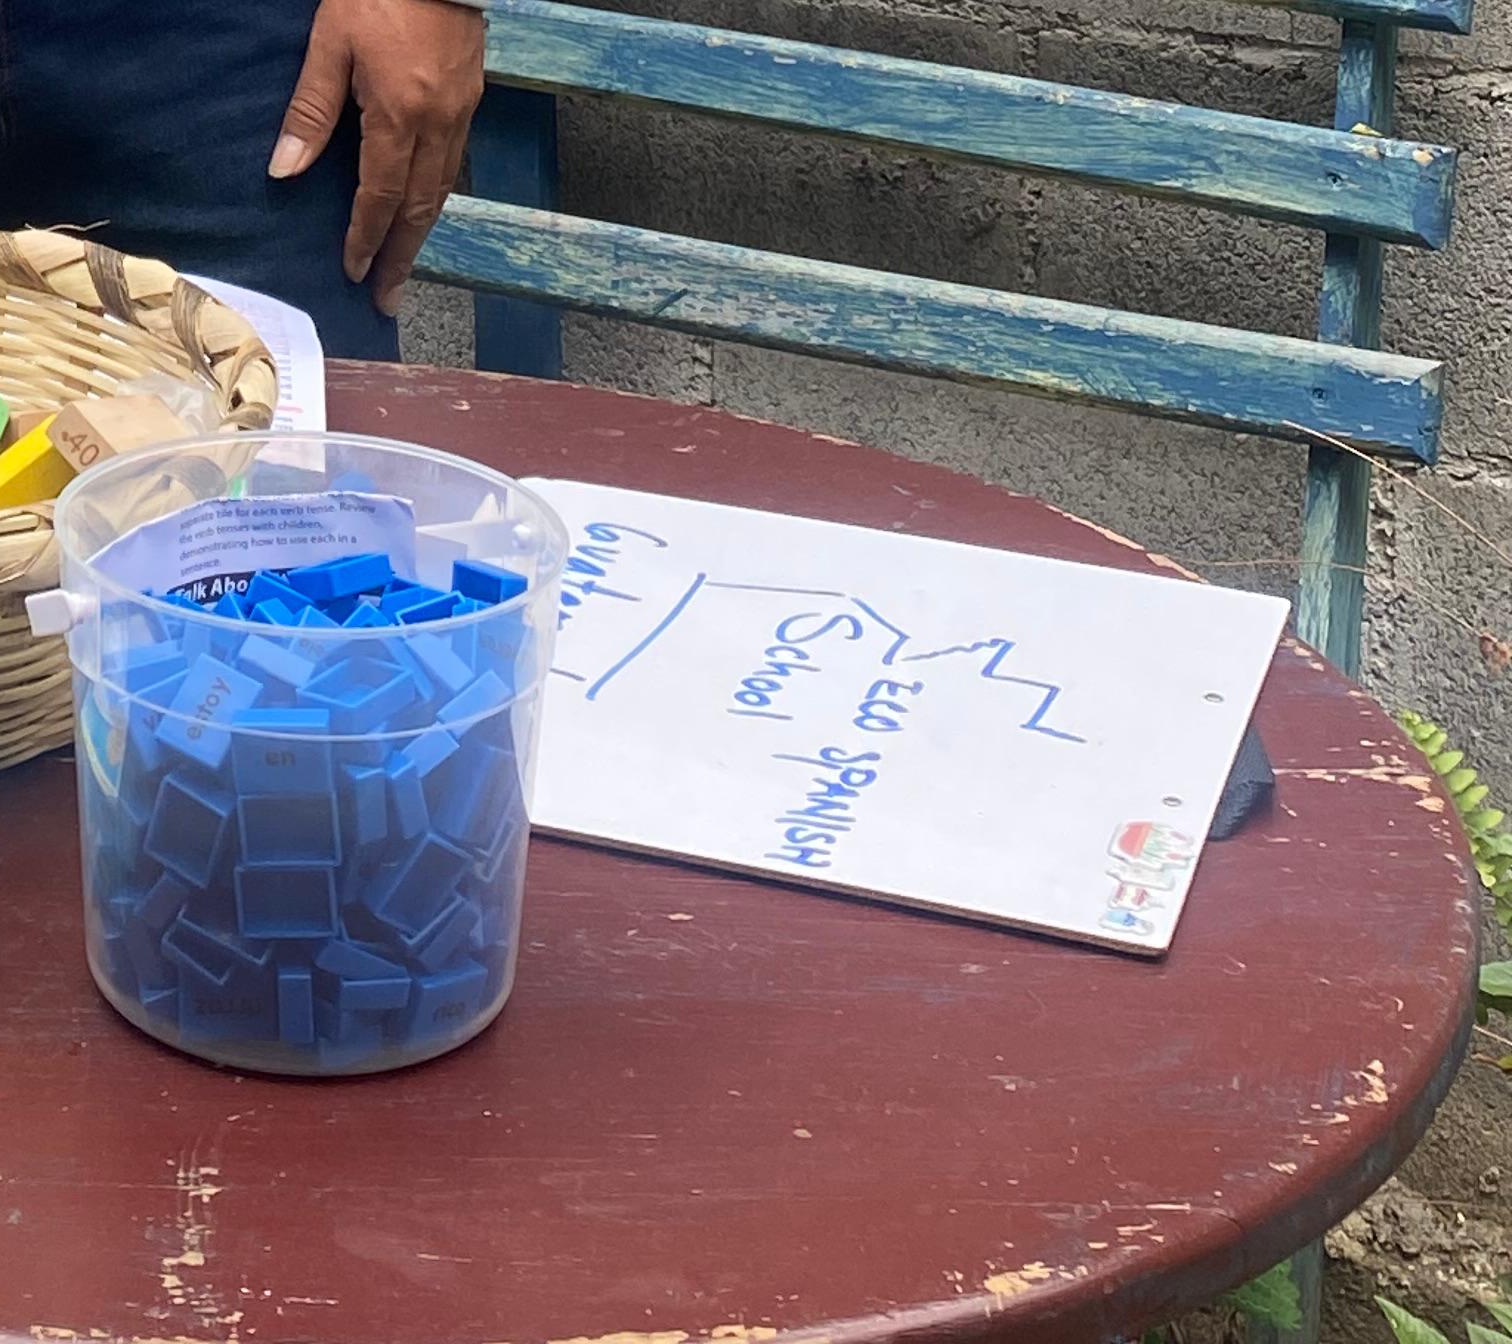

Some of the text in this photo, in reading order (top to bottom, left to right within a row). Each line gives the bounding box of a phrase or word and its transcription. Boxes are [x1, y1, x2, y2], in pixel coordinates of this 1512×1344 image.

[235, 507, 249, 518] for
[251, 506, 278, 517] each
[280, 504, 304, 516] verb
[339, 501, 376, 515] Review
[216, 524, 249, 537] tenses
[251, 520, 276, 532] with
[277, 519, 324, 531] children,
[178, 533, 358, 562] demonstrating how to use each in a
[209, 575, 248, 598] Abo
[725, 611, 865, 722] School
[763, 745, 883, 869] SPANISH
